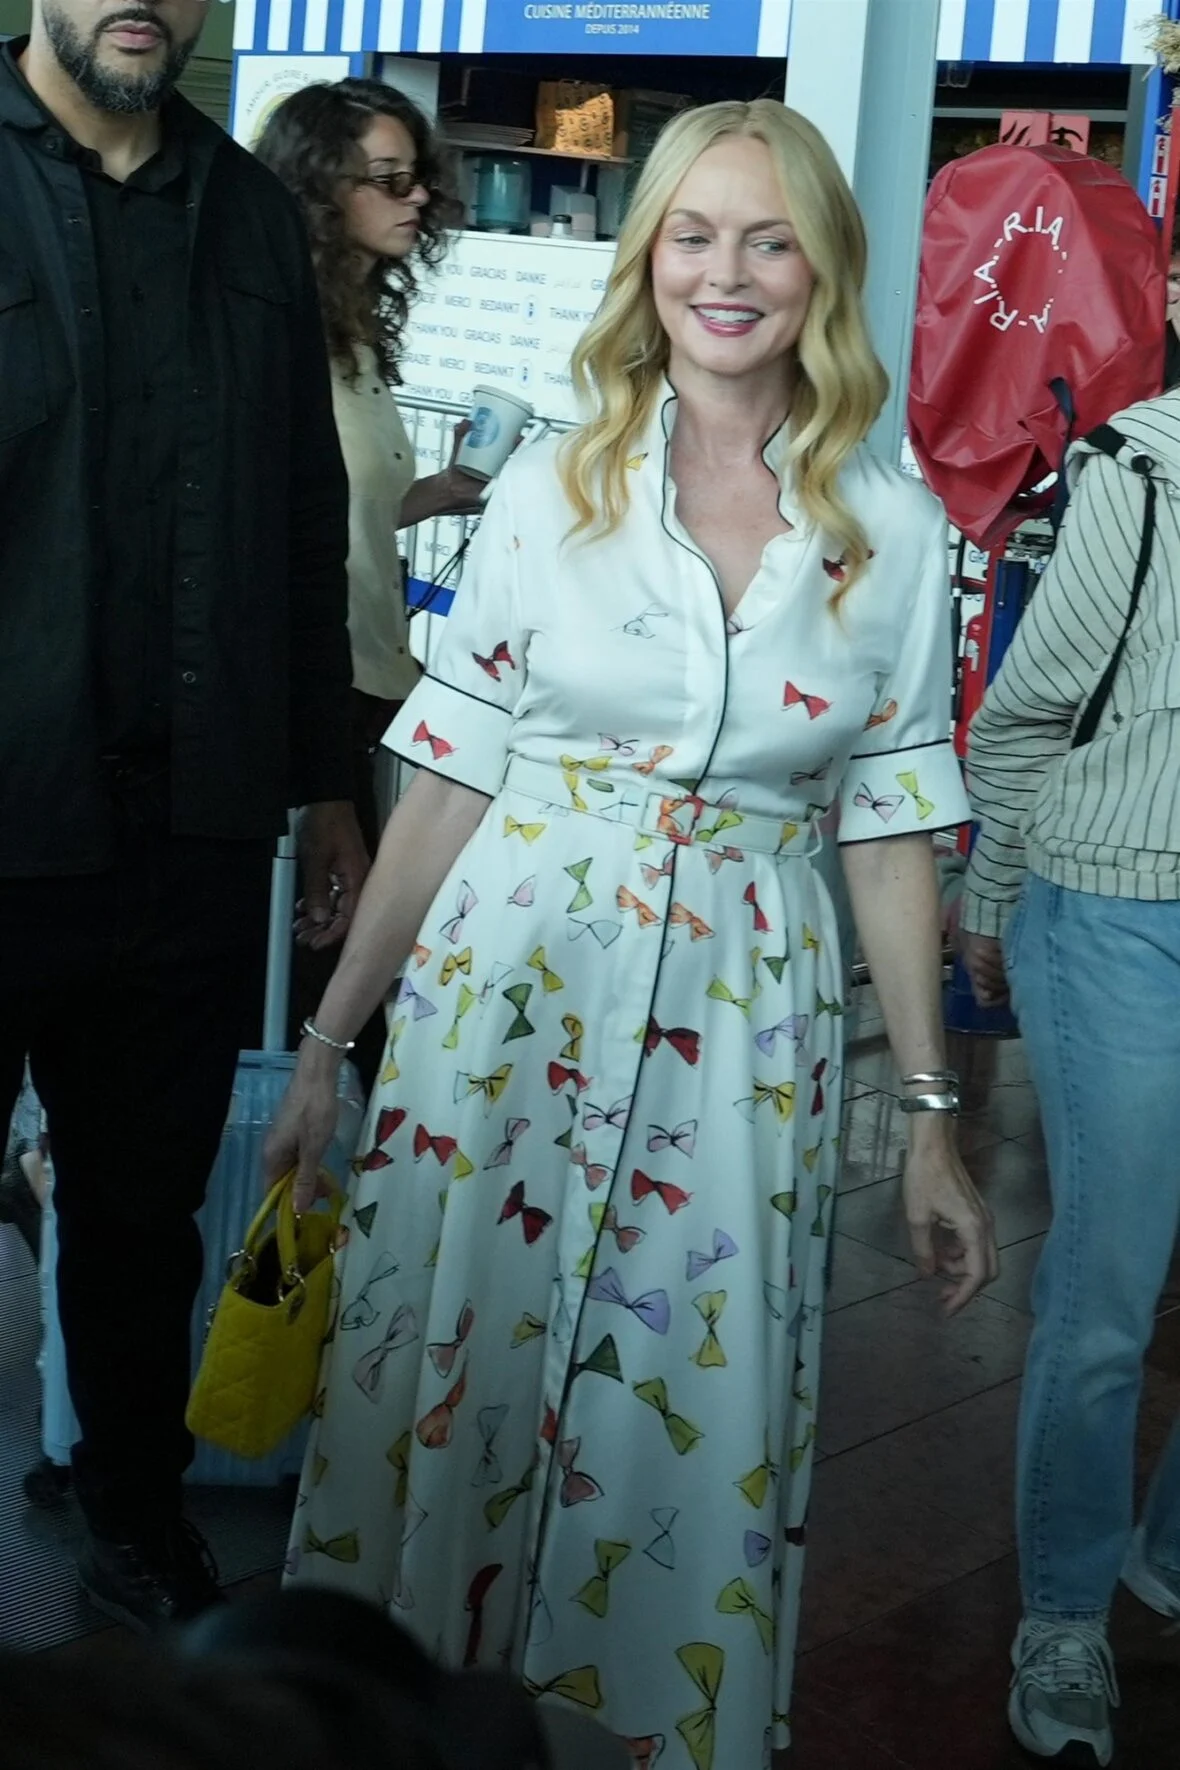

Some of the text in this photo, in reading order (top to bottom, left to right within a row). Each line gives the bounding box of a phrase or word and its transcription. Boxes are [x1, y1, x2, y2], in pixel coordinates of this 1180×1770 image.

[524, 1, 711, 20] CUISINE MÉDITERRANNÉENNE
[584, 23, 616, 35] DEPUIS
[469, 265, 508, 281] GRACIAS
[515, 270, 547, 286] DANKE
[444, 294, 472, 309] MERCI
[549, 306, 582, 322] THANK
[409, 321, 438, 335] THANK
[440, 325, 458, 338] YOU
[463, 328, 502, 344] GRACIAS
[509, 334, 542, 350] DANKE
[438, 356, 466, 371] MERCI
